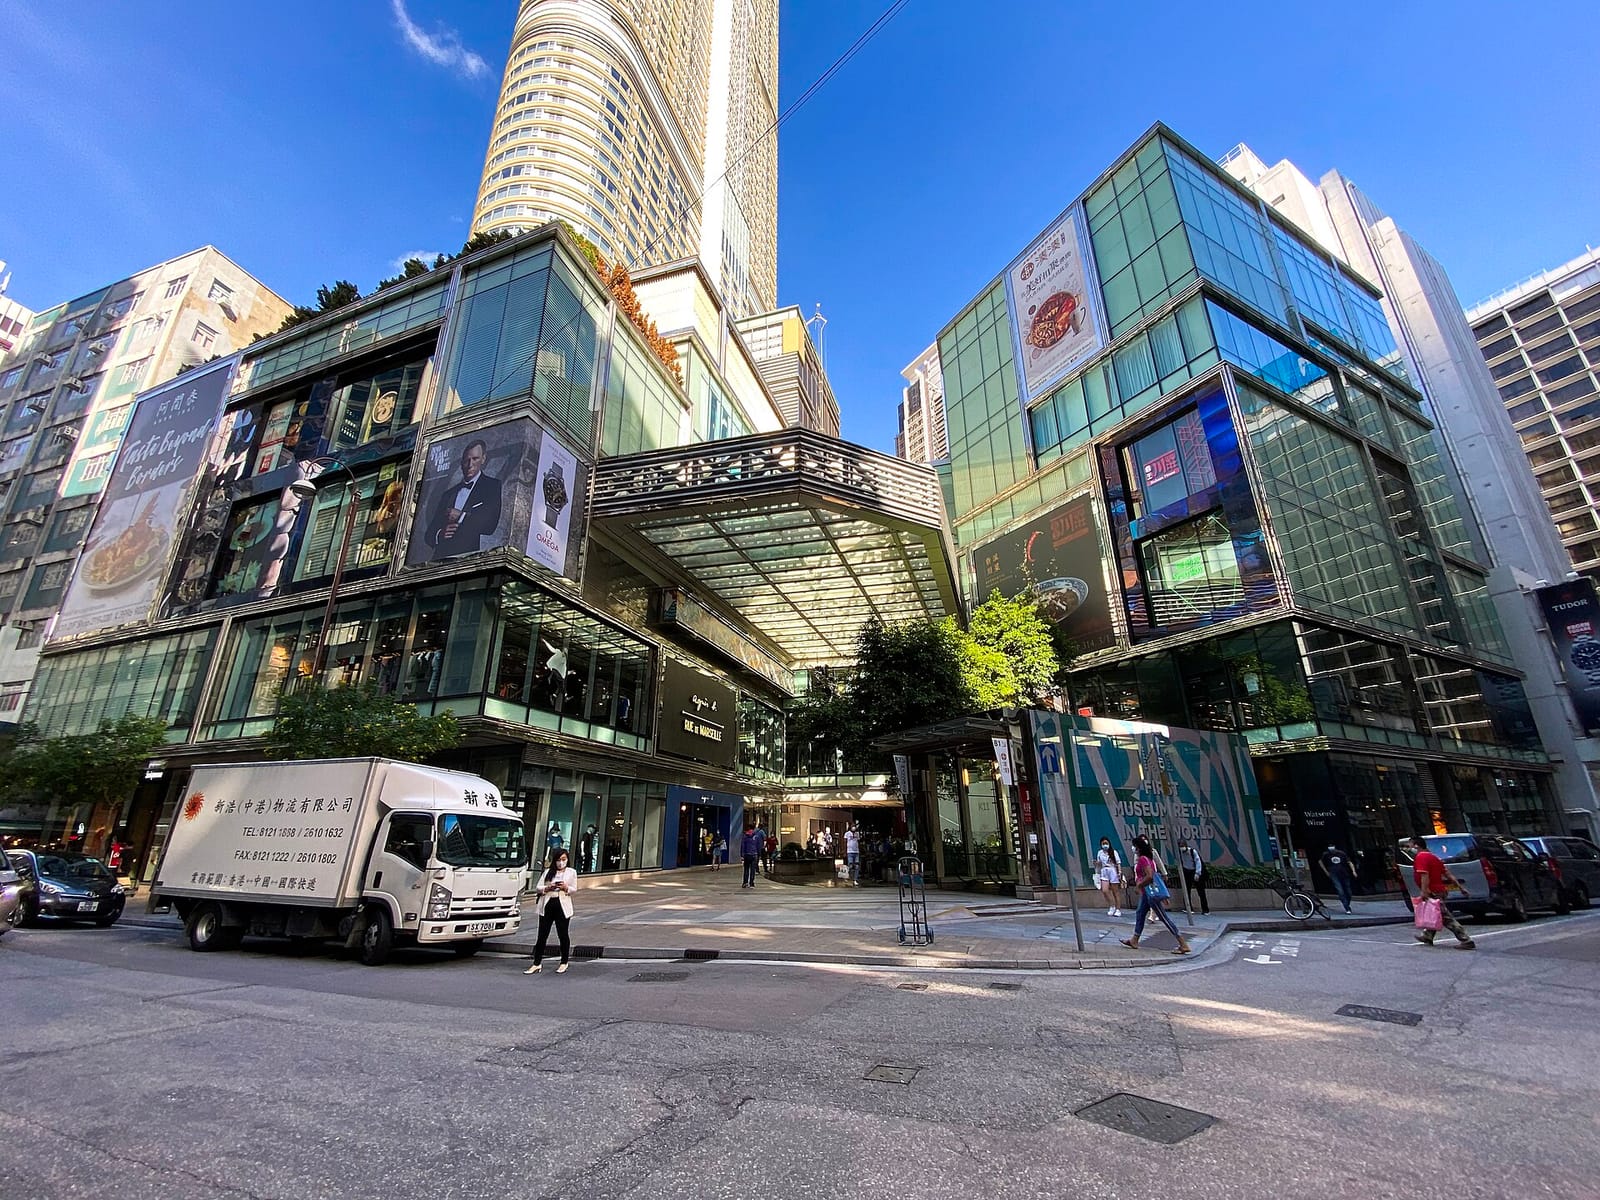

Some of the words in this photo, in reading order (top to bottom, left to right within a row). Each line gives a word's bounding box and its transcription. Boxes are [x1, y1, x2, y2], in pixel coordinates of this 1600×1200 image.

[120, 435, 160, 472] Taste
[158, 418, 211, 458] Beyond
[124, 455, 184, 490] Borders
[536, 533, 559, 552] OMEGA
[1552, 599, 1588, 612] TUDOR
[684, 719, 694, 732] RUE
[700, 724, 722, 741] MARSEILLE
[464, 789, 498, 808] 新浩
[1114, 801, 1168, 817] MUSEUM
[1174, 802, 1216, 818] RETAIL
[1304, 810, 1336, 818] Watson's
[303, 828, 323, 838] 2610
[324, 828, 344, 838] 1632
[1124, 823, 1137, 840] IN
[1140, 824, 1167, 840] THE
[1171, 824, 1216, 840] WORLD
[271, 852, 290, 862] 1222
[297, 853, 317, 863] 2610
[318, 854, 337, 864] 1802
